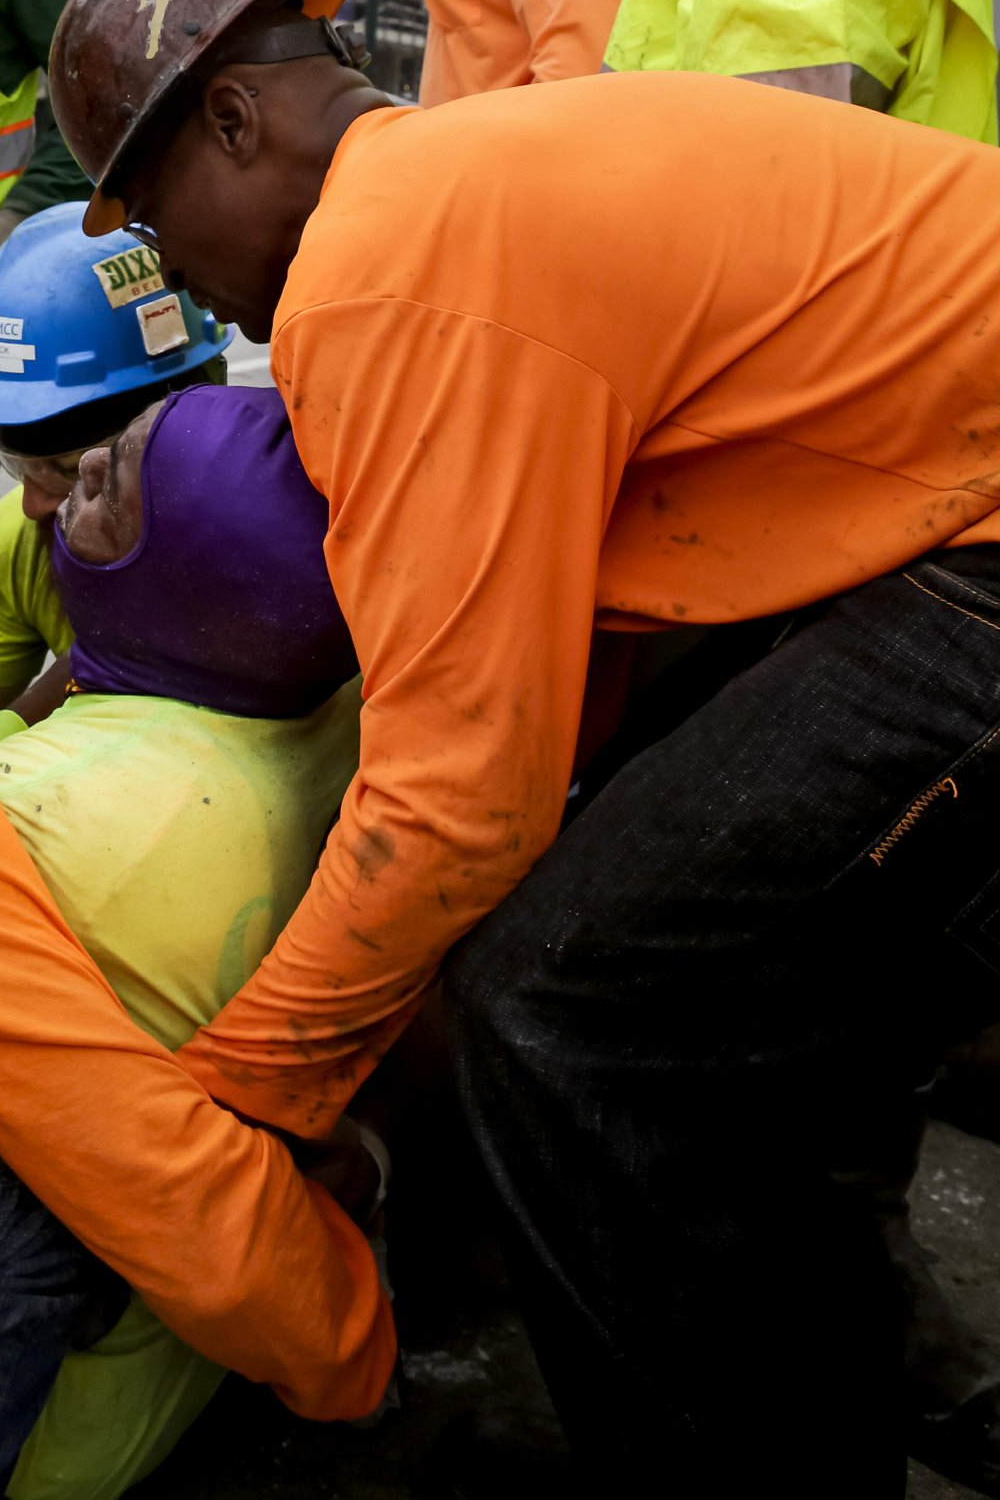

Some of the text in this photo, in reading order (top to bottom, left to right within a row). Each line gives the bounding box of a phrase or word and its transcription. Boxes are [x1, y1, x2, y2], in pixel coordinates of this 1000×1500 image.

[100, 247, 160, 291] DIXI
[132, 279, 161, 296] BEE
[144, 304, 176, 321] HILTI
